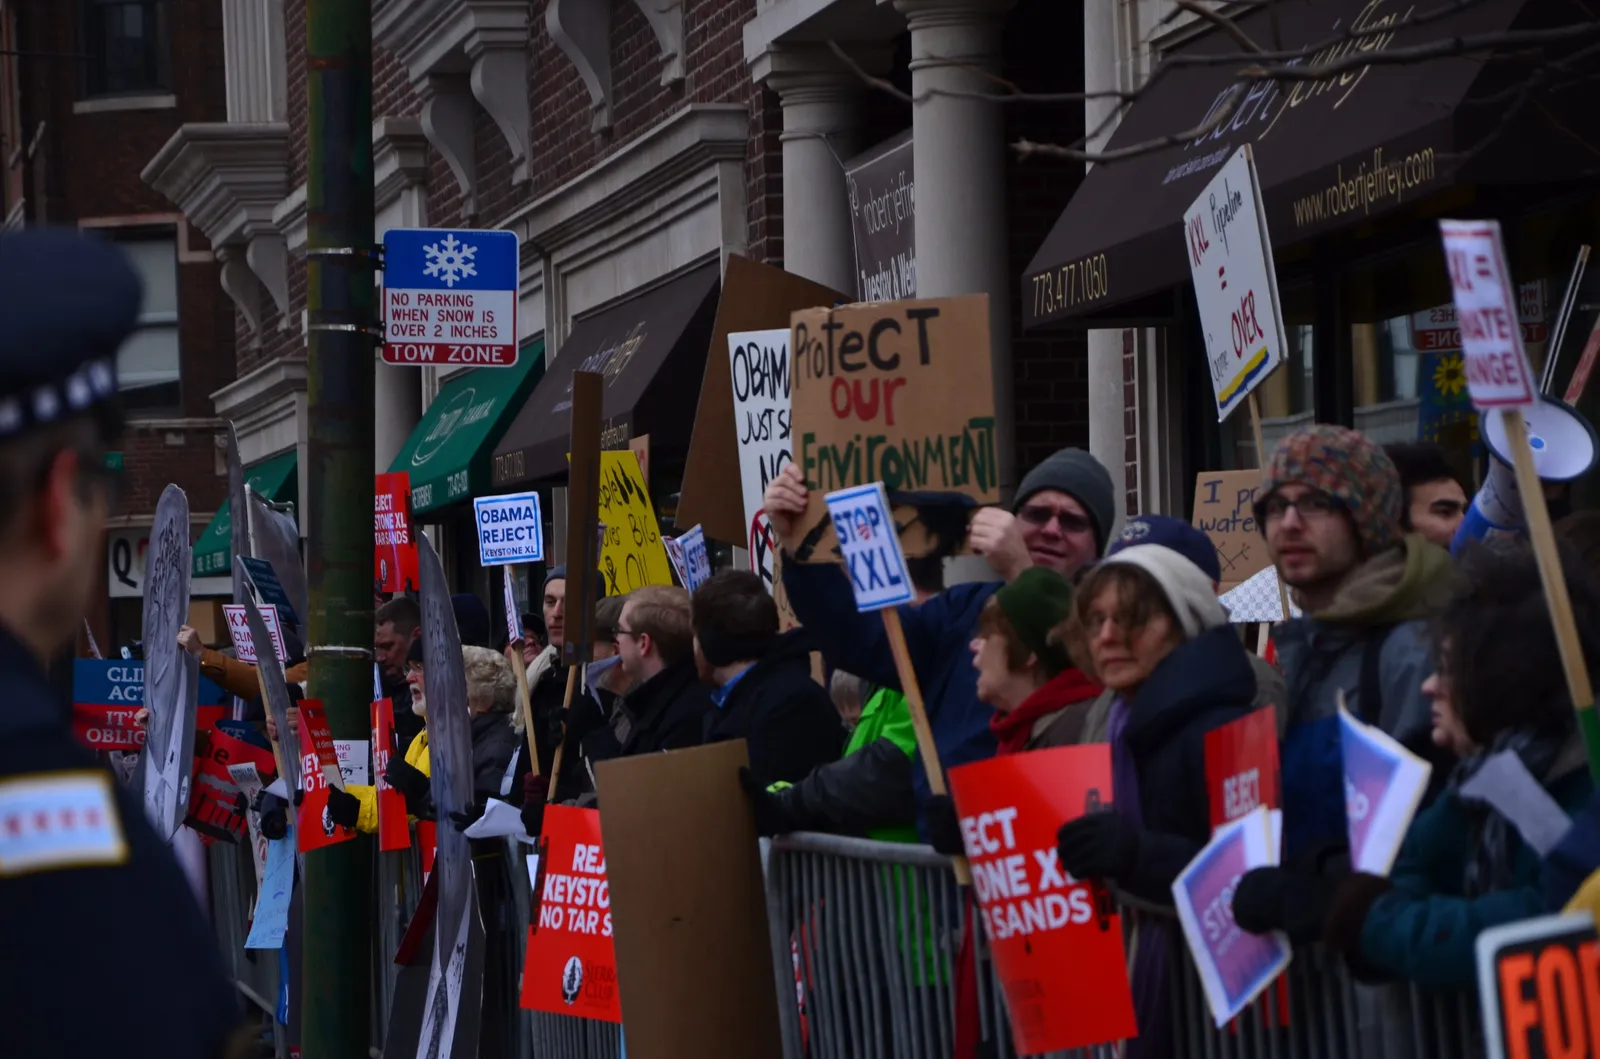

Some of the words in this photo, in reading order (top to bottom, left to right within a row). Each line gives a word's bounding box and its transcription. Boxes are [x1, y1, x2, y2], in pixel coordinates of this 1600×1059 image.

[1033, 252, 1108, 317] 773.477.1050
[391, 293, 409, 306] NO
[418, 293, 474, 307] PARKING
[391, 308, 429, 321] WHEN
[437, 309, 474, 322] SNOW
[482, 310, 494, 323] IS
[1231, 289, 1264, 359] OVER
[391, 324, 426, 337] OVER
[434, 325, 442, 337] 2
[451, 325, 498, 338] INCHES
[391, 344, 436, 361] TOW
[447, 345, 504, 363] ZONE
[732, 341, 791, 402] OBAM
[831, 375, 906, 427] our
[741, 408, 775, 445] JUST
[1203, 479, 1223, 504] I
[395, 511, 408, 529] XL
[481, 506, 534, 524] OBAMA
[834, 505, 880, 545] STOP
[483, 526, 535, 544] REJECT
[485, 545, 523, 557] KEYSTONE
[524, 545, 536, 554] XL
[539, 904, 564, 931] NO
[567, 907, 600, 935] TAR
[990, 887, 1093, 941] SANDS
